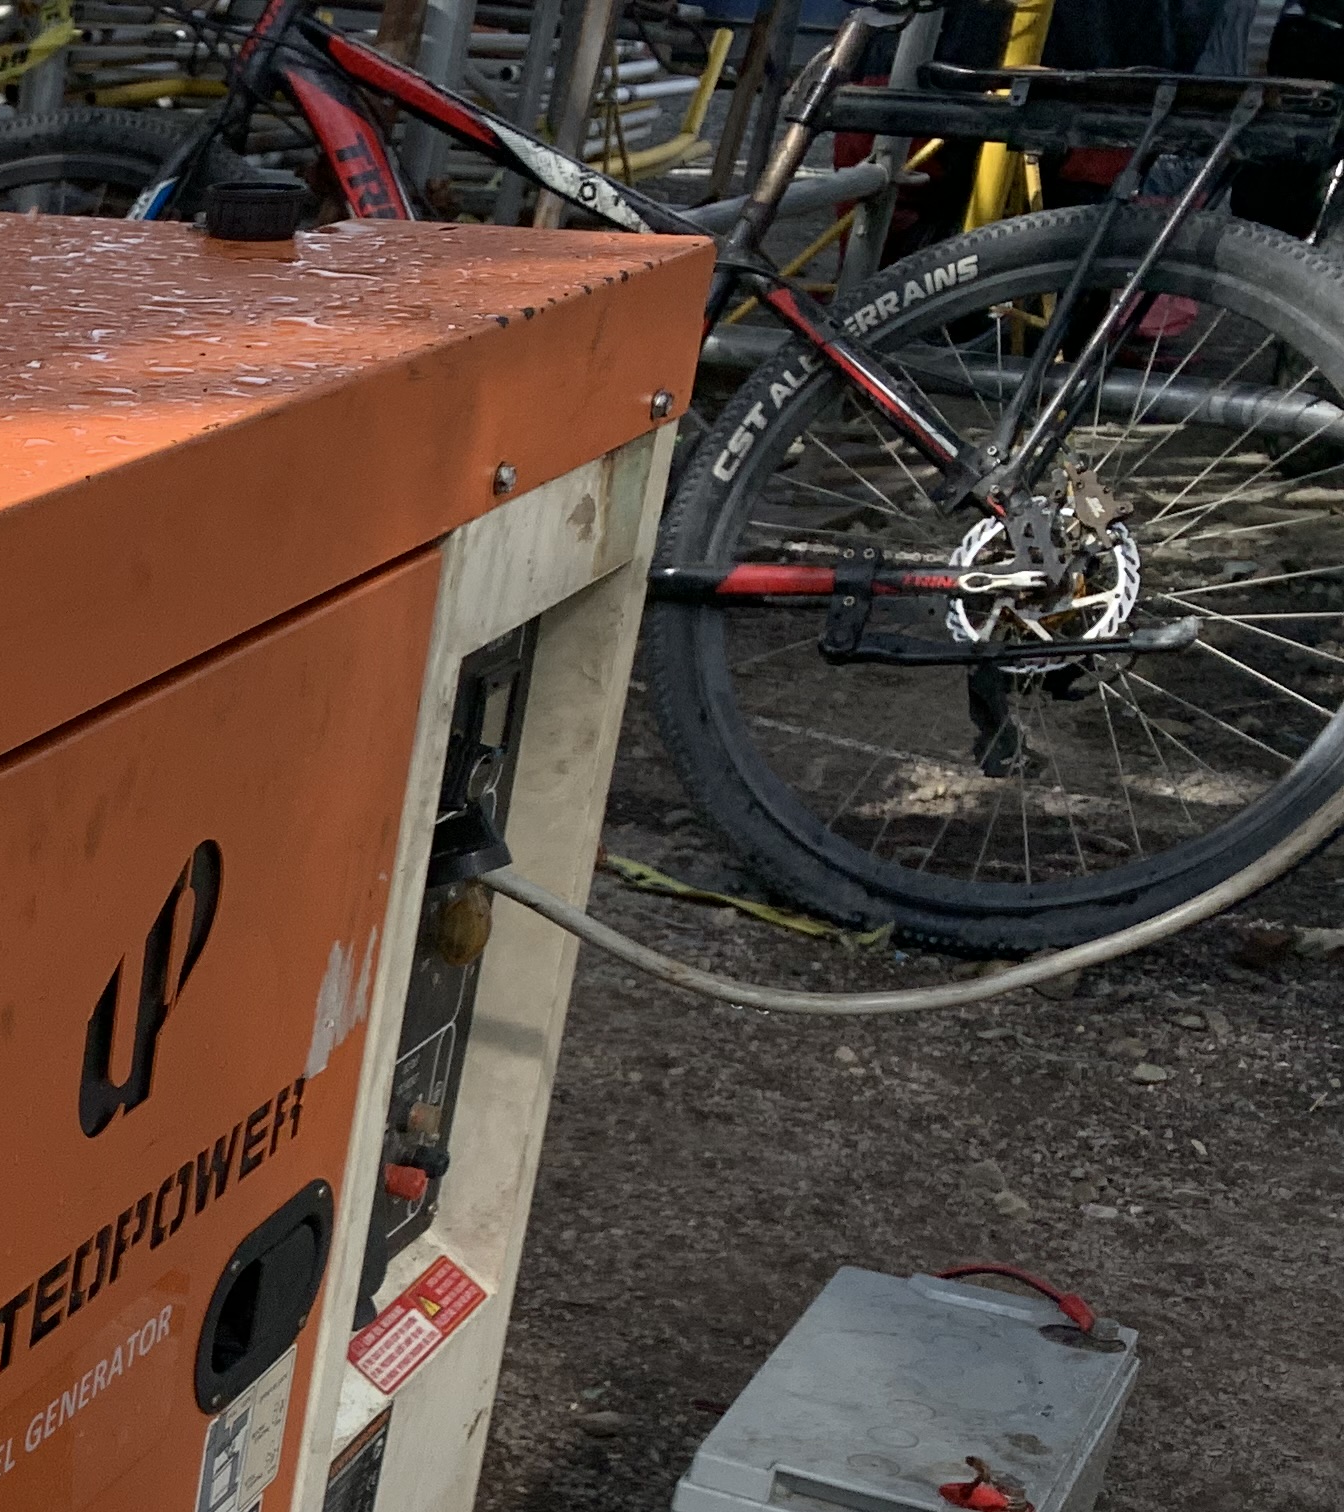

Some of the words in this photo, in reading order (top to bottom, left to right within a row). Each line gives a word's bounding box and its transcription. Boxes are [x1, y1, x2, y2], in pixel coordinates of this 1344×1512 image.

[713, 401, 767, 483] CST
[844, 254, 979, 337] ERRAINS
[25, 1304, 172, 1453] GENERATOR
